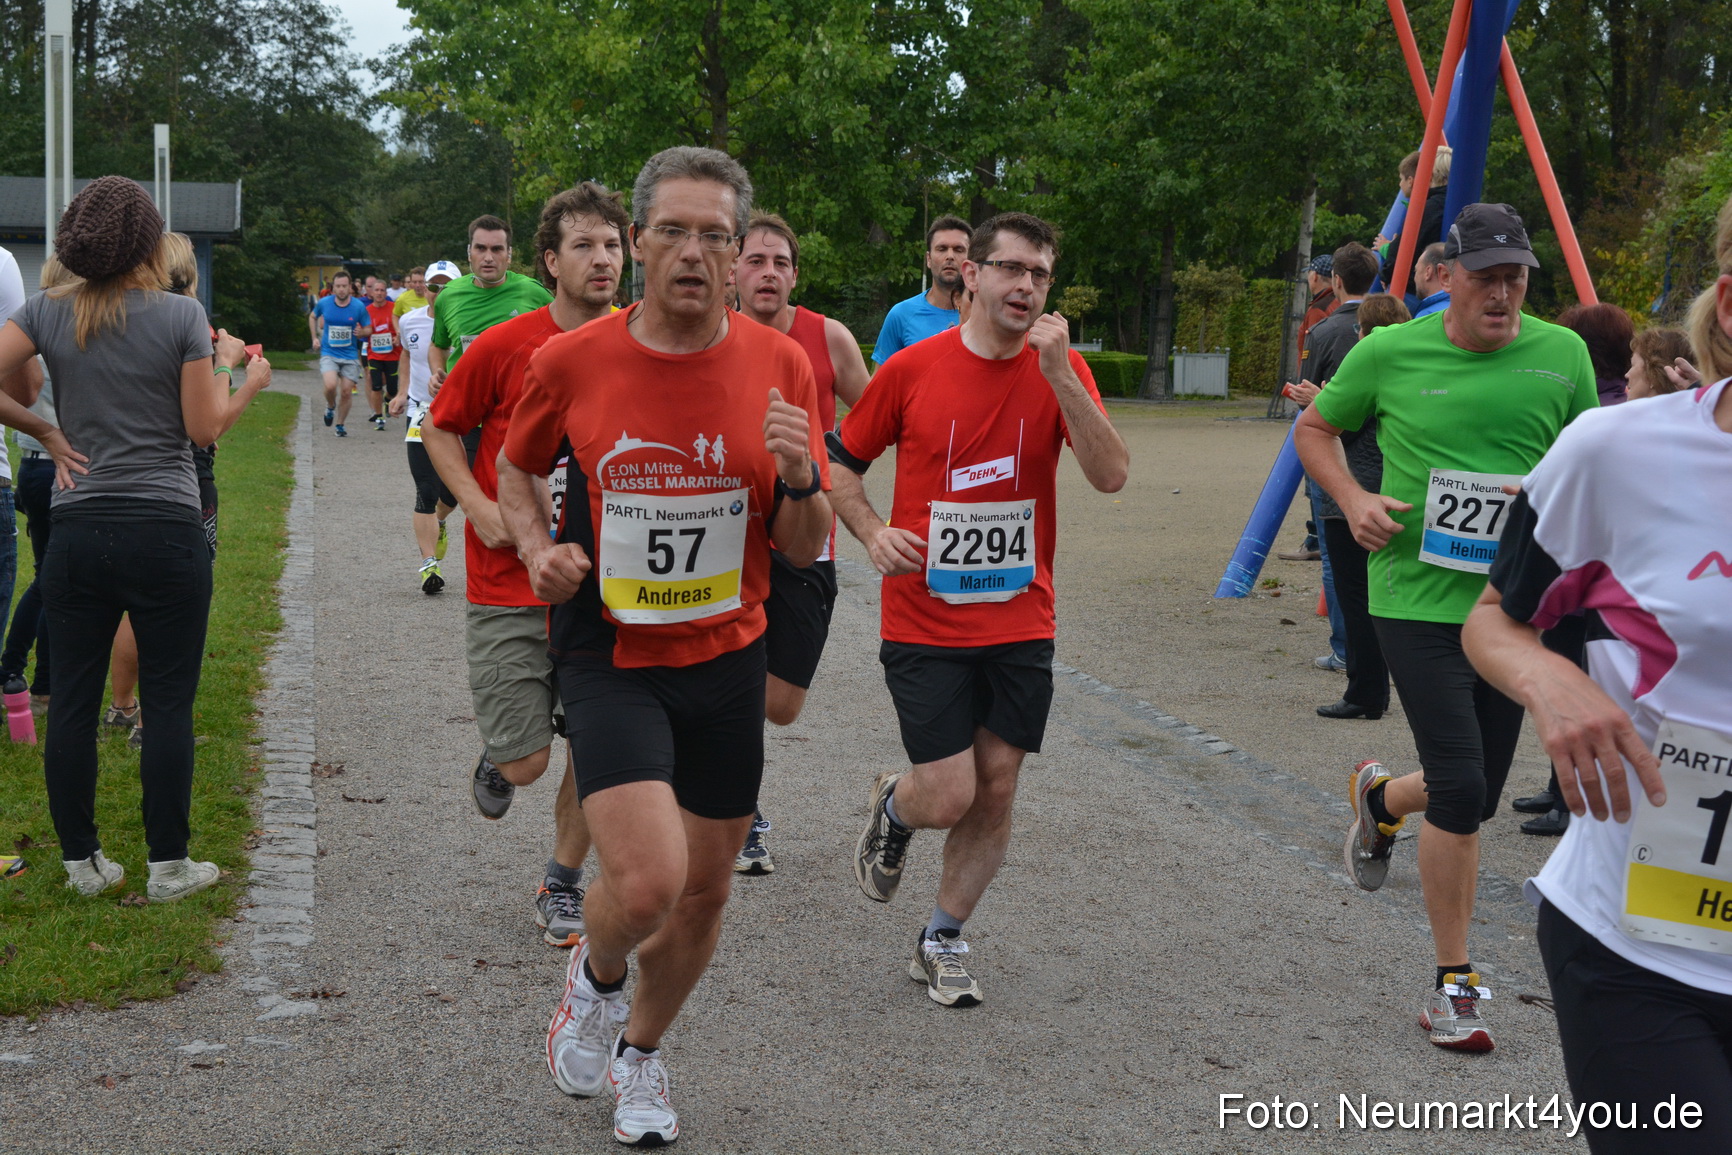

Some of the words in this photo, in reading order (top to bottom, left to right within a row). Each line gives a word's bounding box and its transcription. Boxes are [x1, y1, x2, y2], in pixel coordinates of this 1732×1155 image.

[608, 463, 639, 477] E.ON
[644, 462, 683, 476] Mitte
[969, 466, 997, 482] DEHN
[610, 476, 661, 491] KASSEL
[665, 476, 742, 489] MARATHON
[1432, 476, 1468, 491] PARTL
[606, 503, 652, 520] PARTL
[656, 506, 724, 521] Neumarkt
[932, 511, 967, 523] PARTL
[970, 512, 1020, 523] Neumarkt
[1436, 493, 1515, 535] 227
[647, 527, 706, 575] 57
[940, 526, 1027, 565] 2294
[1450, 541, 1497, 560] Helmu
[960, 574, 1005, 590] Martin
[636, 586, 712, 605] Andreas
[1697, 790, 1732, 866] 1
[1696, 888, 1732, 922] He
